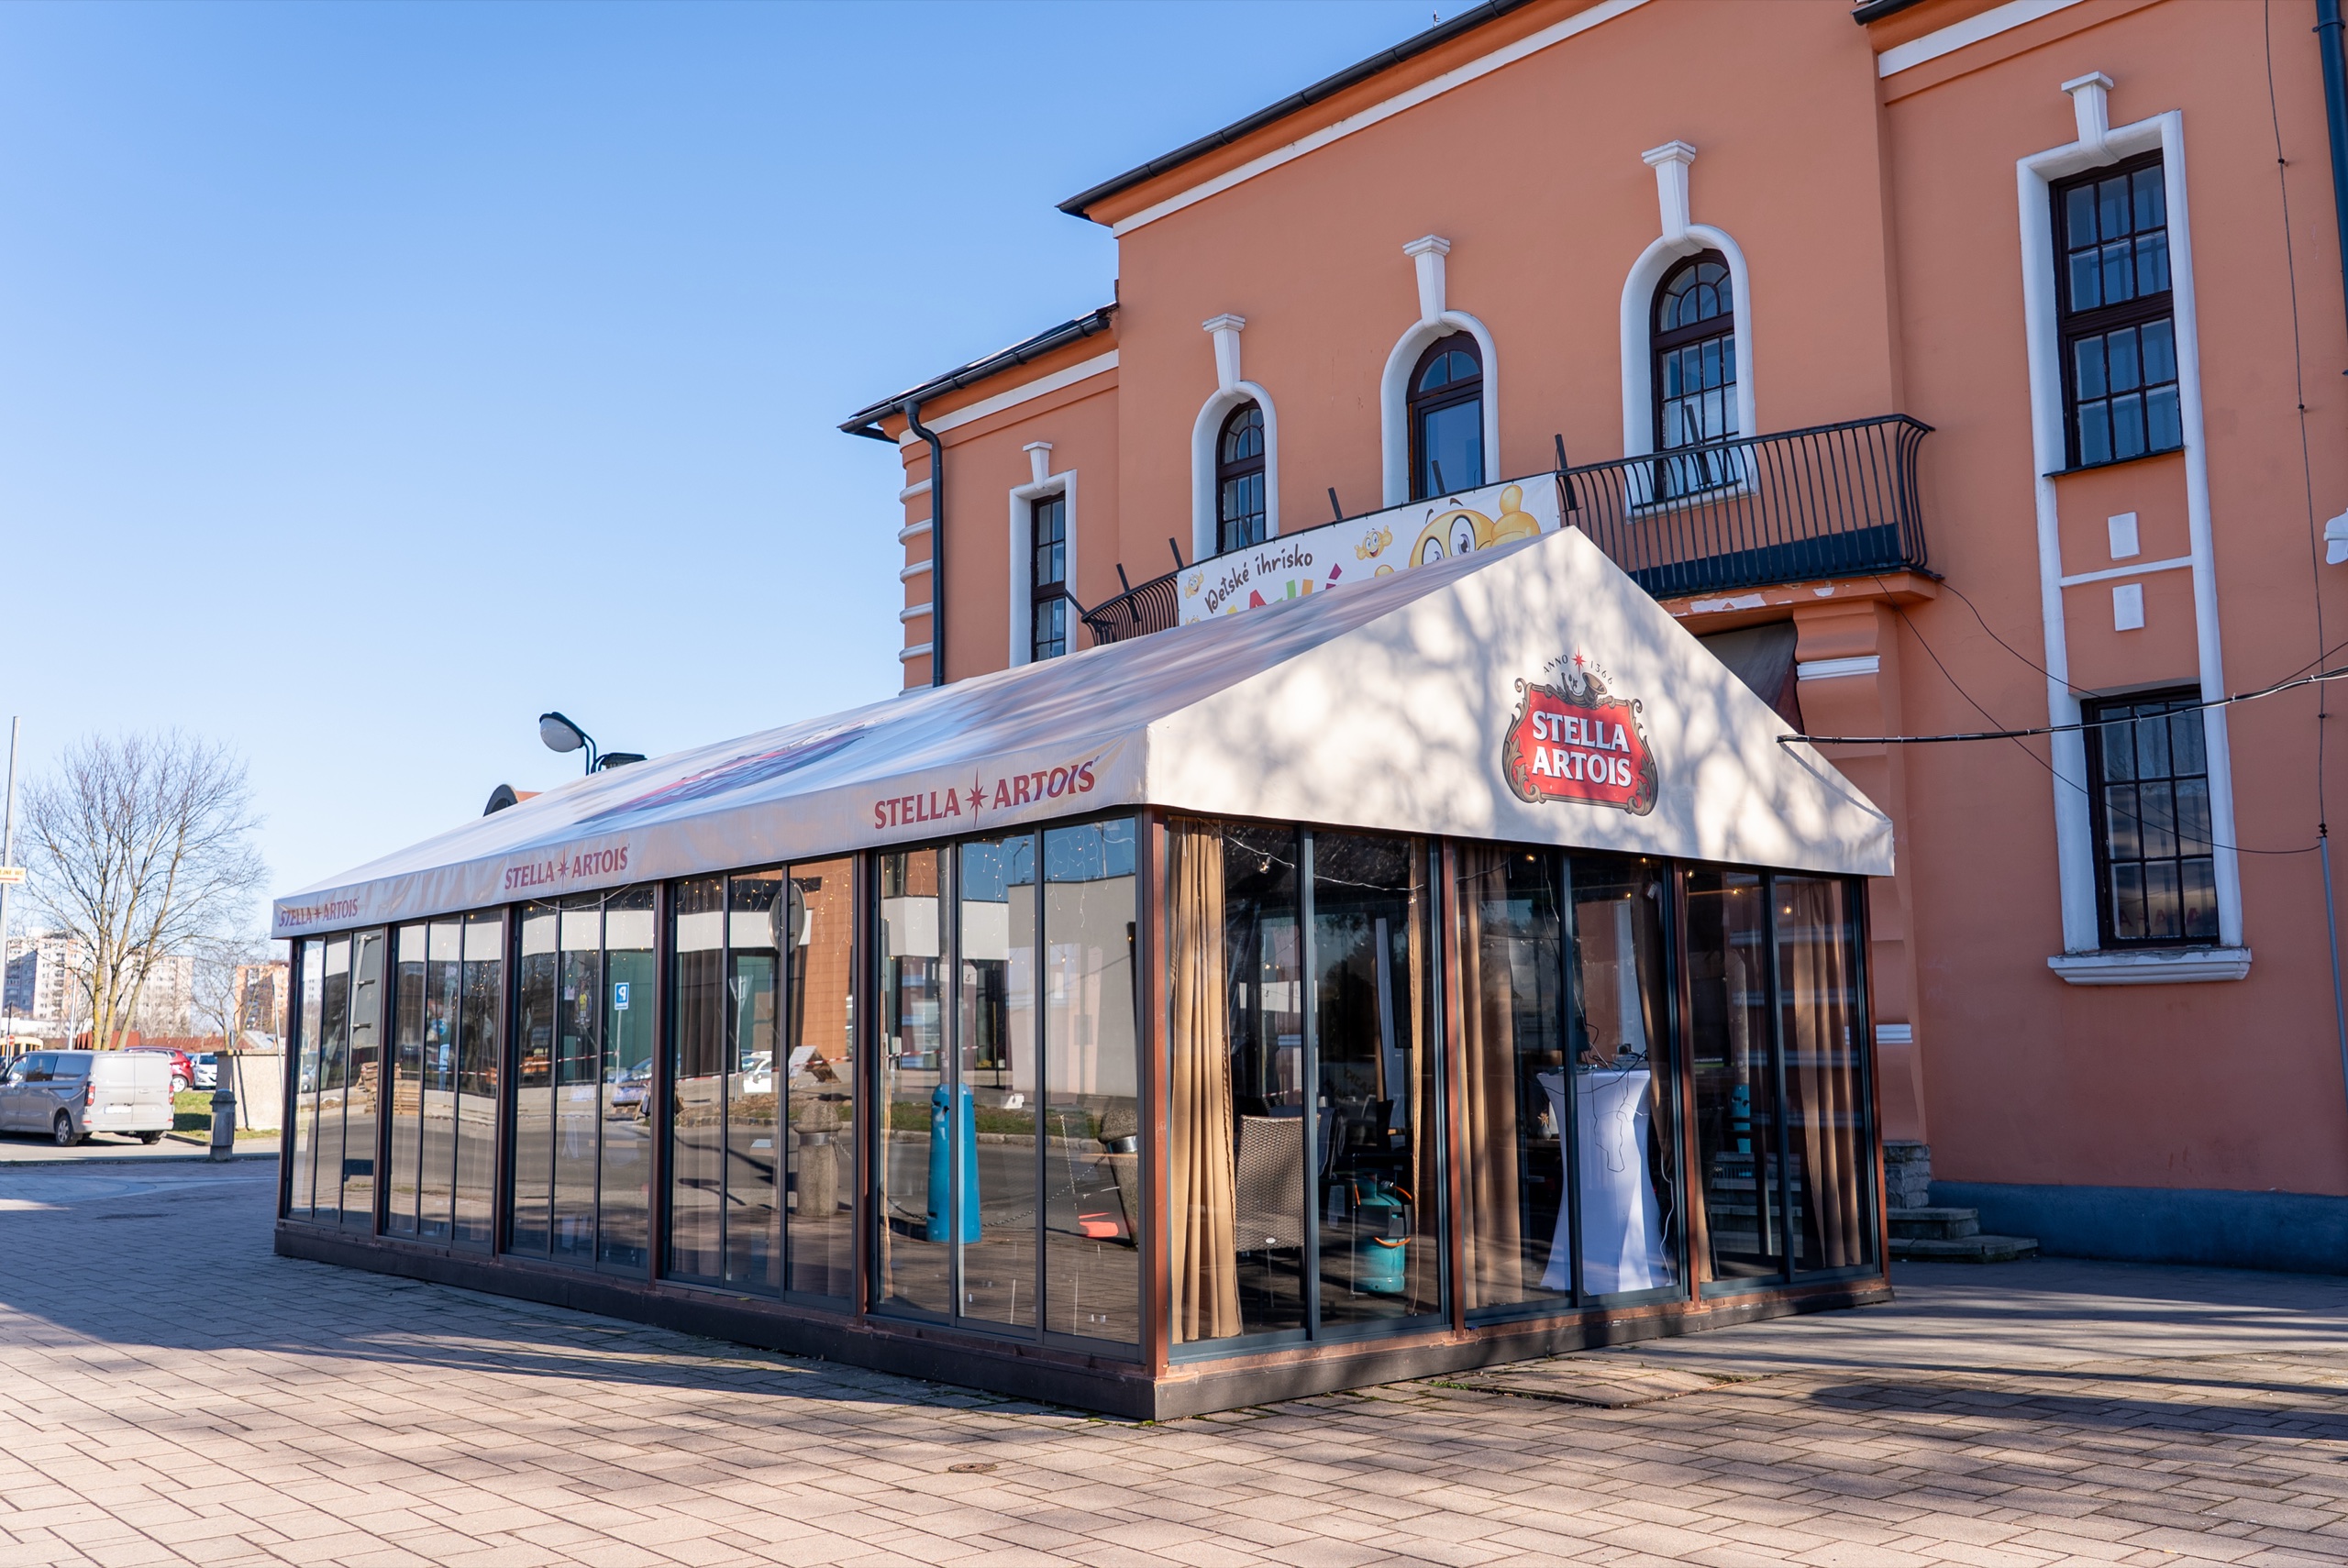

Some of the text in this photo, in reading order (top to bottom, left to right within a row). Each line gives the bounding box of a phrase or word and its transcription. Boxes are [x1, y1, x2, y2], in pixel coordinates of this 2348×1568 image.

[1204, 561, 1249, 614] Detské
[1543, 654, 1613, 685] ANNO 1366
[1532, 710, 1631, 754] STELLA
[1532, 745, 1633, 788] ARTOIS
[874, 760, 1095, 830] STELLA ARTOIS
[504, 845, 628, 890] STELLA ARTOIS
[278, 898, 360, 928] STELLA ARTOIS
